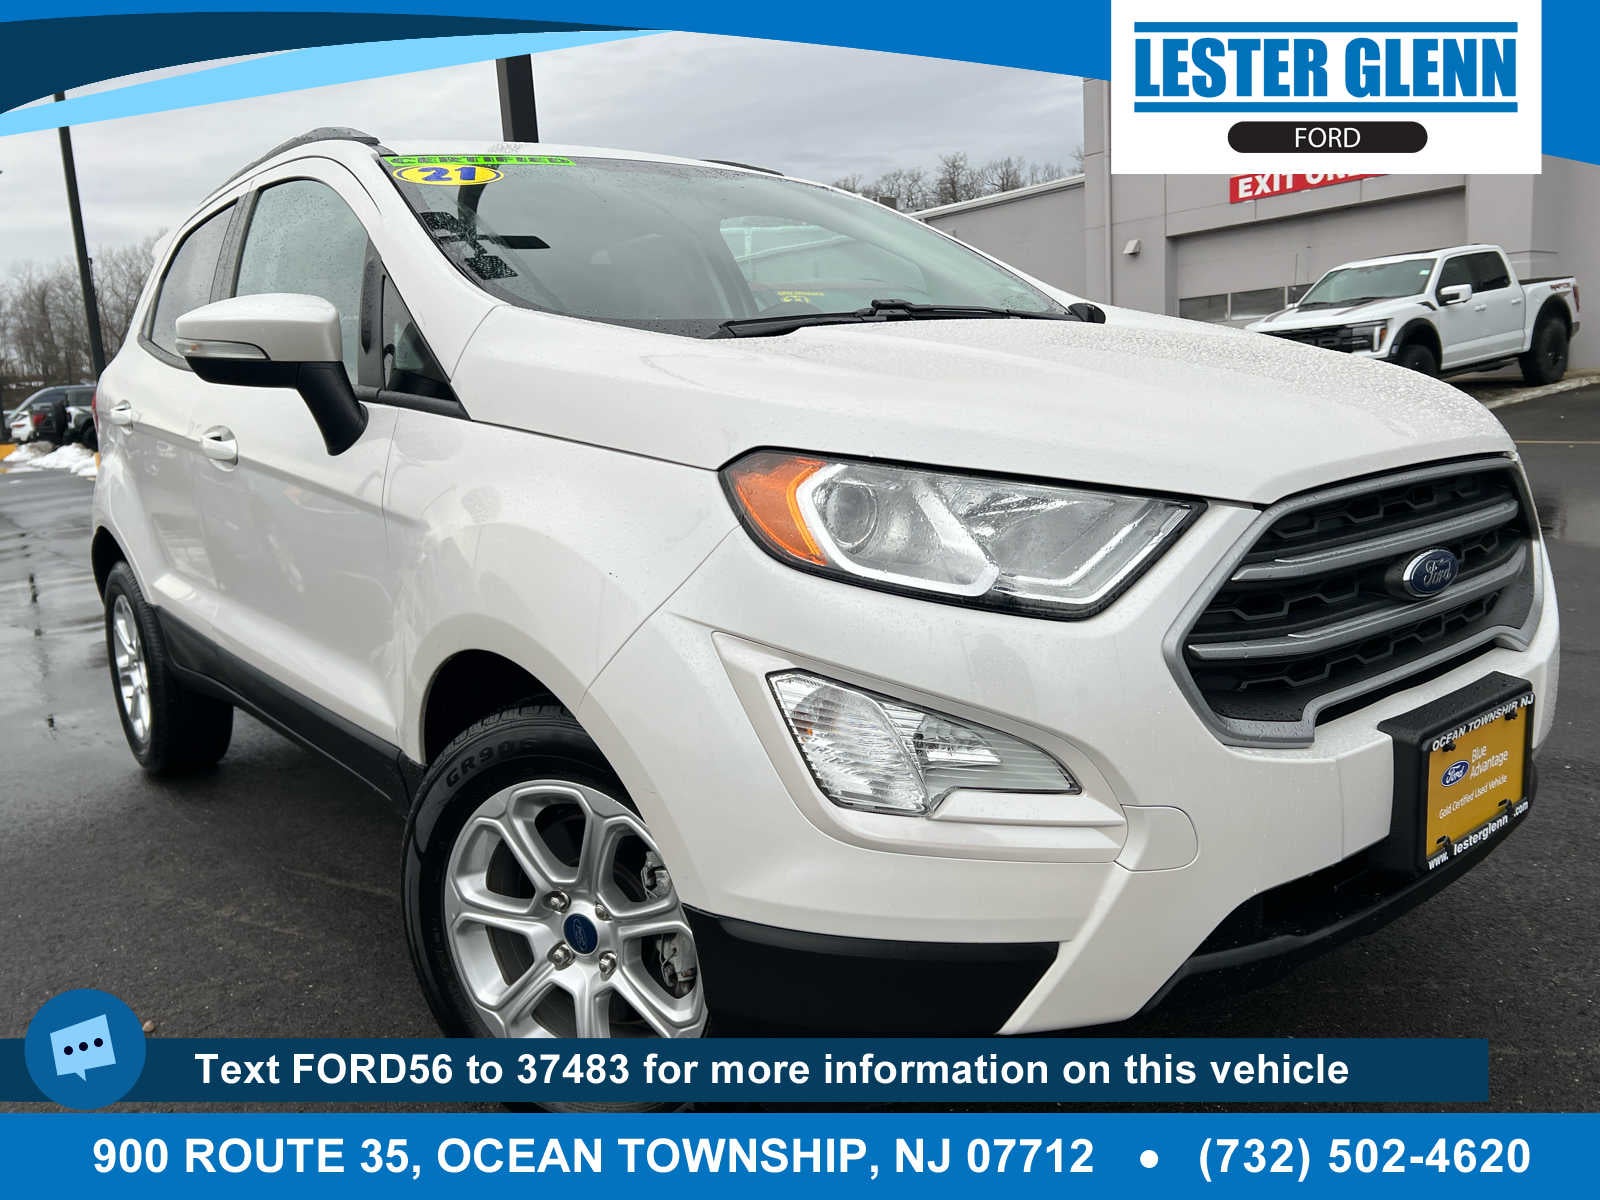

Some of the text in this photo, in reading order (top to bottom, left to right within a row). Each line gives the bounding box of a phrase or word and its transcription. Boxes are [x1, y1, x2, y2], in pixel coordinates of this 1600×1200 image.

[391, 155, 571, 165] CERTIFIED
[417, 166, 476, 181] 21
[1238, 174, 1296, 199] EXIT
[1423, 558, 1451, 586] Ford
[1432, 726, 1466, 751] OCEAN
[1520, 694, 1534, 708] NJ
[1469, 750, 1509, 780] Advantage
[1471, 745, 1487, 763] Blue
[1445, 764, 1465, 784] Ford
[1452, 789, 1474, 811] Certified
[1474, 785, 1488, 798] Used
[1488, 774, 1508, 790] Vehicle
[1428, 801, 1529, 871] www. lesterglenn .com
